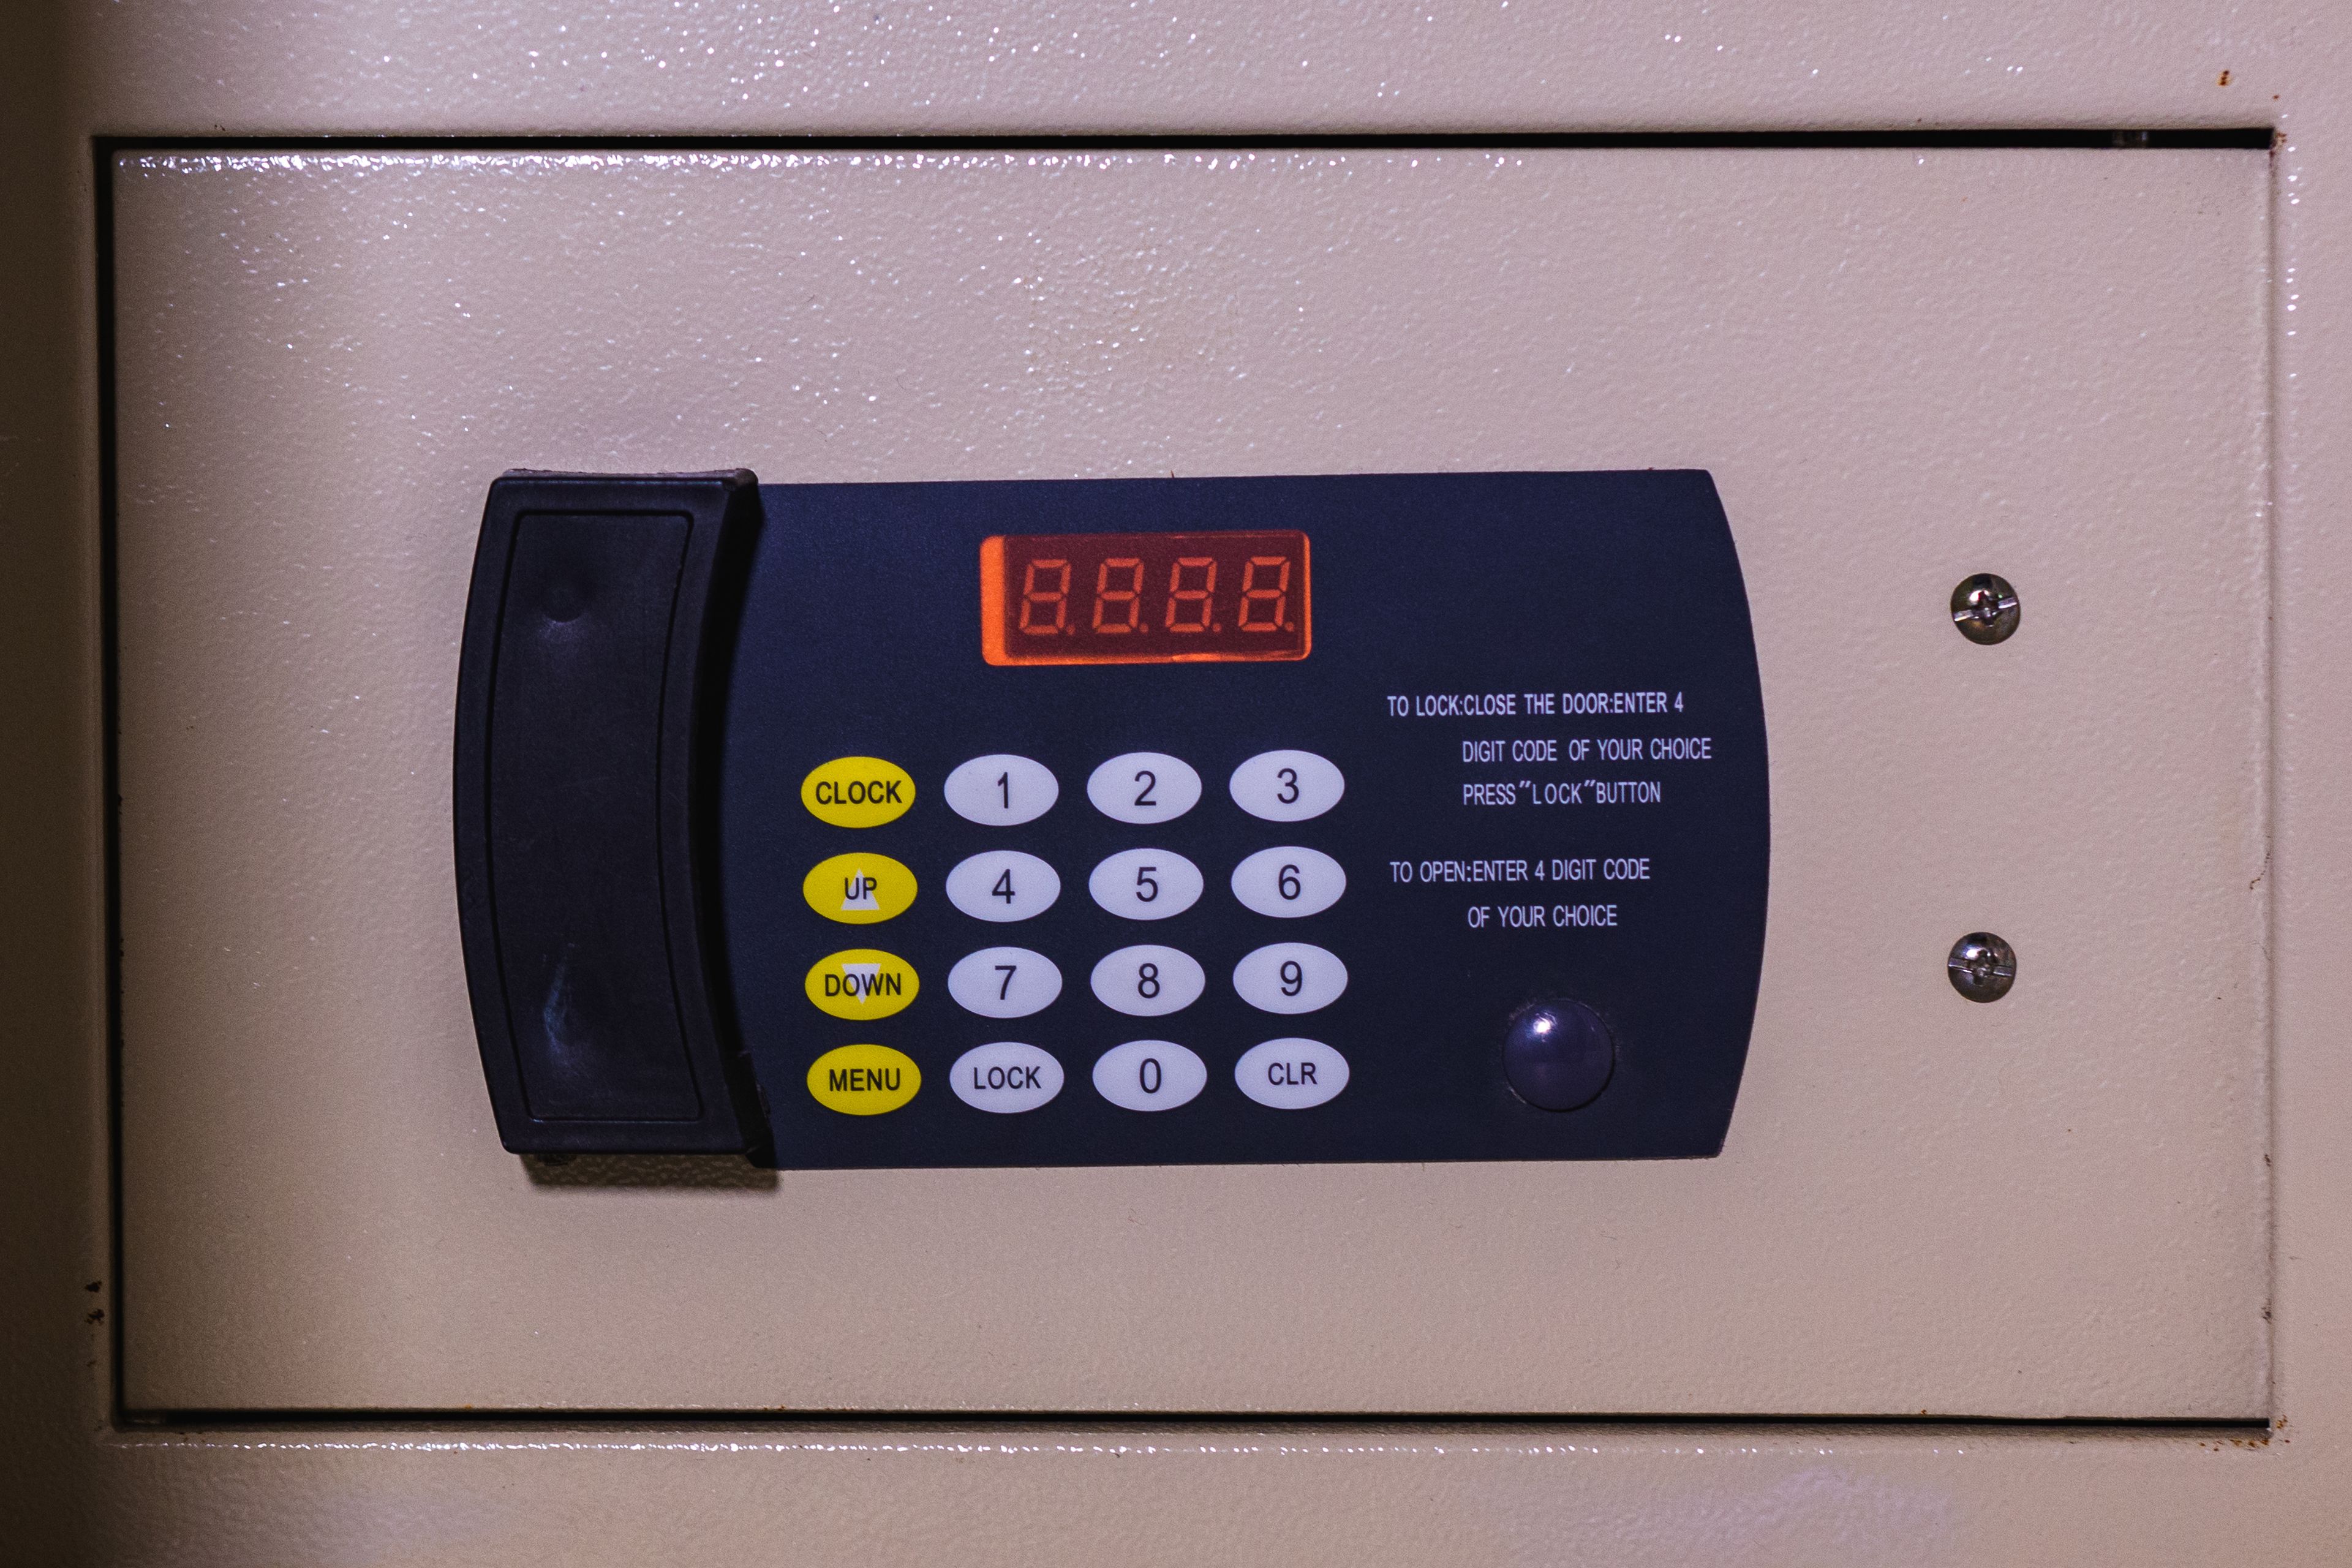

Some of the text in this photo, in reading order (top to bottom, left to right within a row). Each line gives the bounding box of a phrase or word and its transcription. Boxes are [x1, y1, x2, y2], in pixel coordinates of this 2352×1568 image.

[1387, 695, 1409, 717] TO
[1523, 693, 1555, 715] THE
[1674, 692, 1684, 712] 4
[1463, 737, 1712, 763] DIGIT CODE OF YOUR CHOICE
[815, 780, 902, 805] CLOCK
[998, 772, 1009, 809] 1
[1134, 771, 1156, 806] 2
[1277, 768, 1299, 804] 3
[1136, 867, 1158, 902] 5
[1278, 864, 1301, 900] 6
[1389, 861, 1413, 883] TO
[1534, 860, 1545, 881] 4
[1552, 859, 1597, 881] DIGIT
[1604, 858, 1650, 880] CODE
[844, 876, 878, 900] UP
[992, 869, 1016, 904] 4
[1468, 904, 1618, 928] OF YOUR CHOICE
[824, 973, 902, 997] DOWN
[995, 965, 1017, 1000] 7
[1137, 963, 1160, 999] 8
[1280, 960, 1303, 997] 9
[829, 1068, 900, 1092] MENU
[974, 1066, 1041, 1090] LOCK
[1139, 1058, 1162, 1094] 0
[1268, 1062, 1317, 1086] CLR
